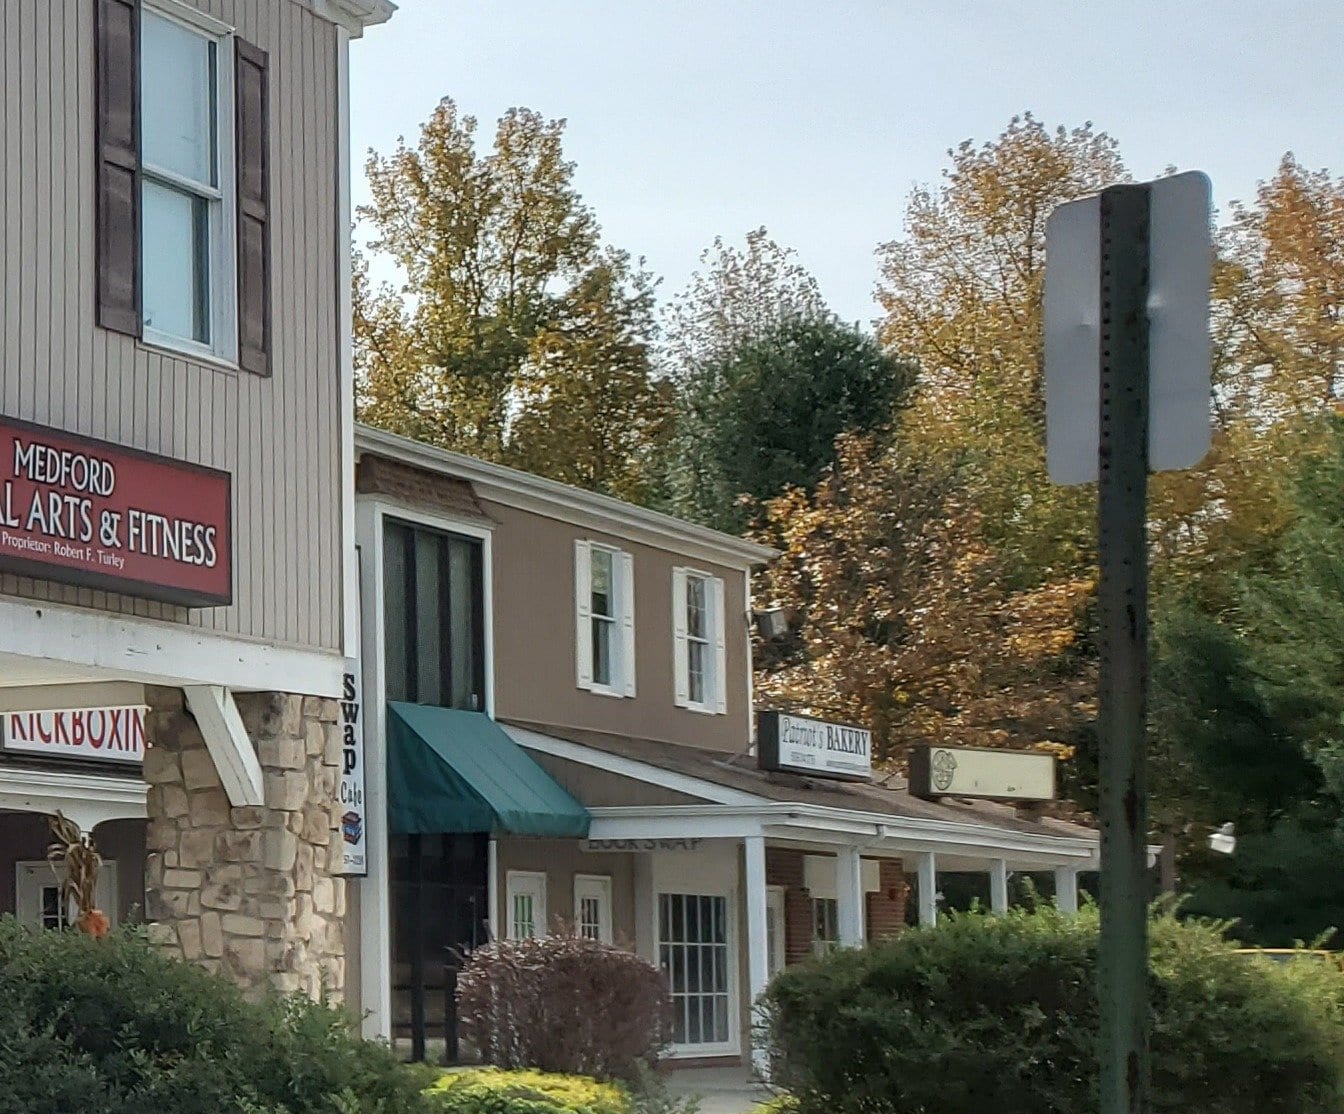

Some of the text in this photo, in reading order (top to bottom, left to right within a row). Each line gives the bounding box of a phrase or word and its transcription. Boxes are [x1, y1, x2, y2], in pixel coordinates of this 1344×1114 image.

[13, 439, 115, 497] MEDFORD
[2, 531, 52, 554] Proprietor:
[54, 541, 83, 560] Robert
[27, 490, 91, 542] ARTS
[100, 511, 122, 548] &
[128, 509, 216, 567] FITNESS
[826, 726, 868, 755] BAKERY
